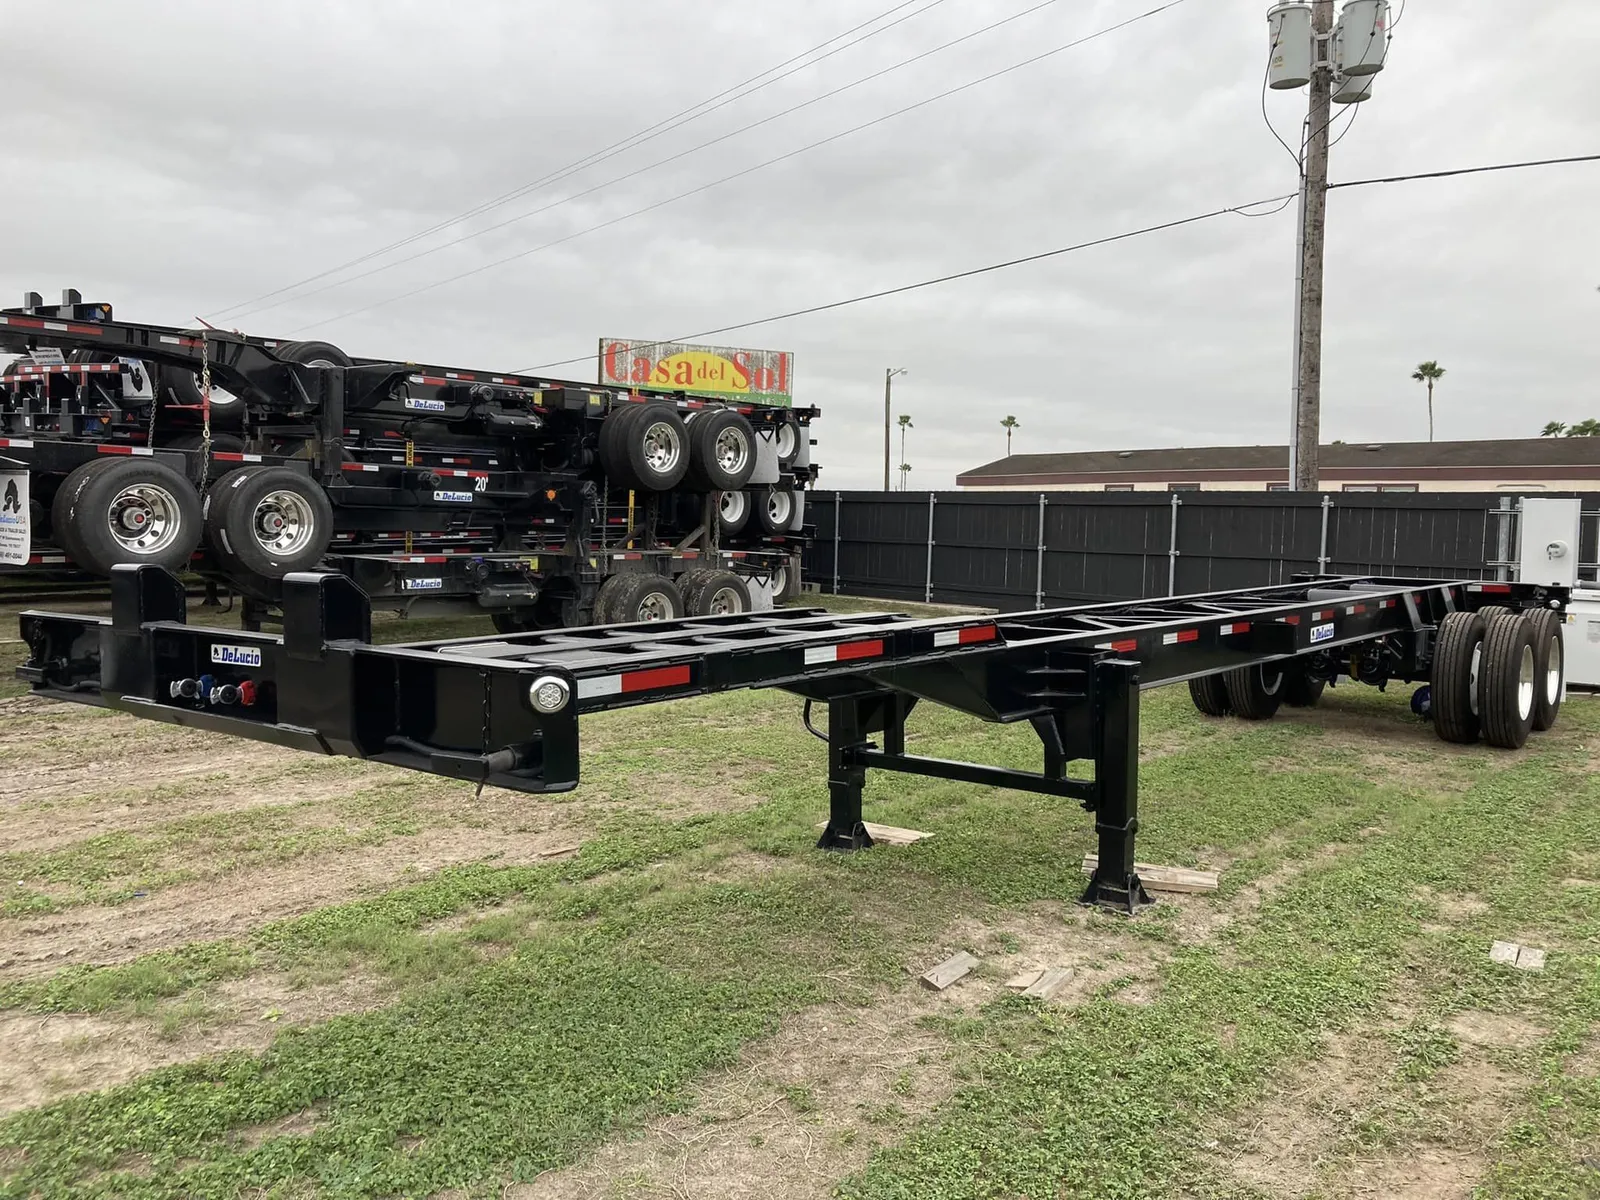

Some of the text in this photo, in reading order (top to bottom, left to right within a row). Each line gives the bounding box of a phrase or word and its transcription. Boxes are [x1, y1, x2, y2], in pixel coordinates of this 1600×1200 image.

[605, 342, 787, 392] Casa del Sol
[414, 400, 444, 410] DeLucio
[442, 492, 472, 501] DeLucio
[411, 579, 441, 588] DeLucio
[222, 647, 260, 665] DeLucio
